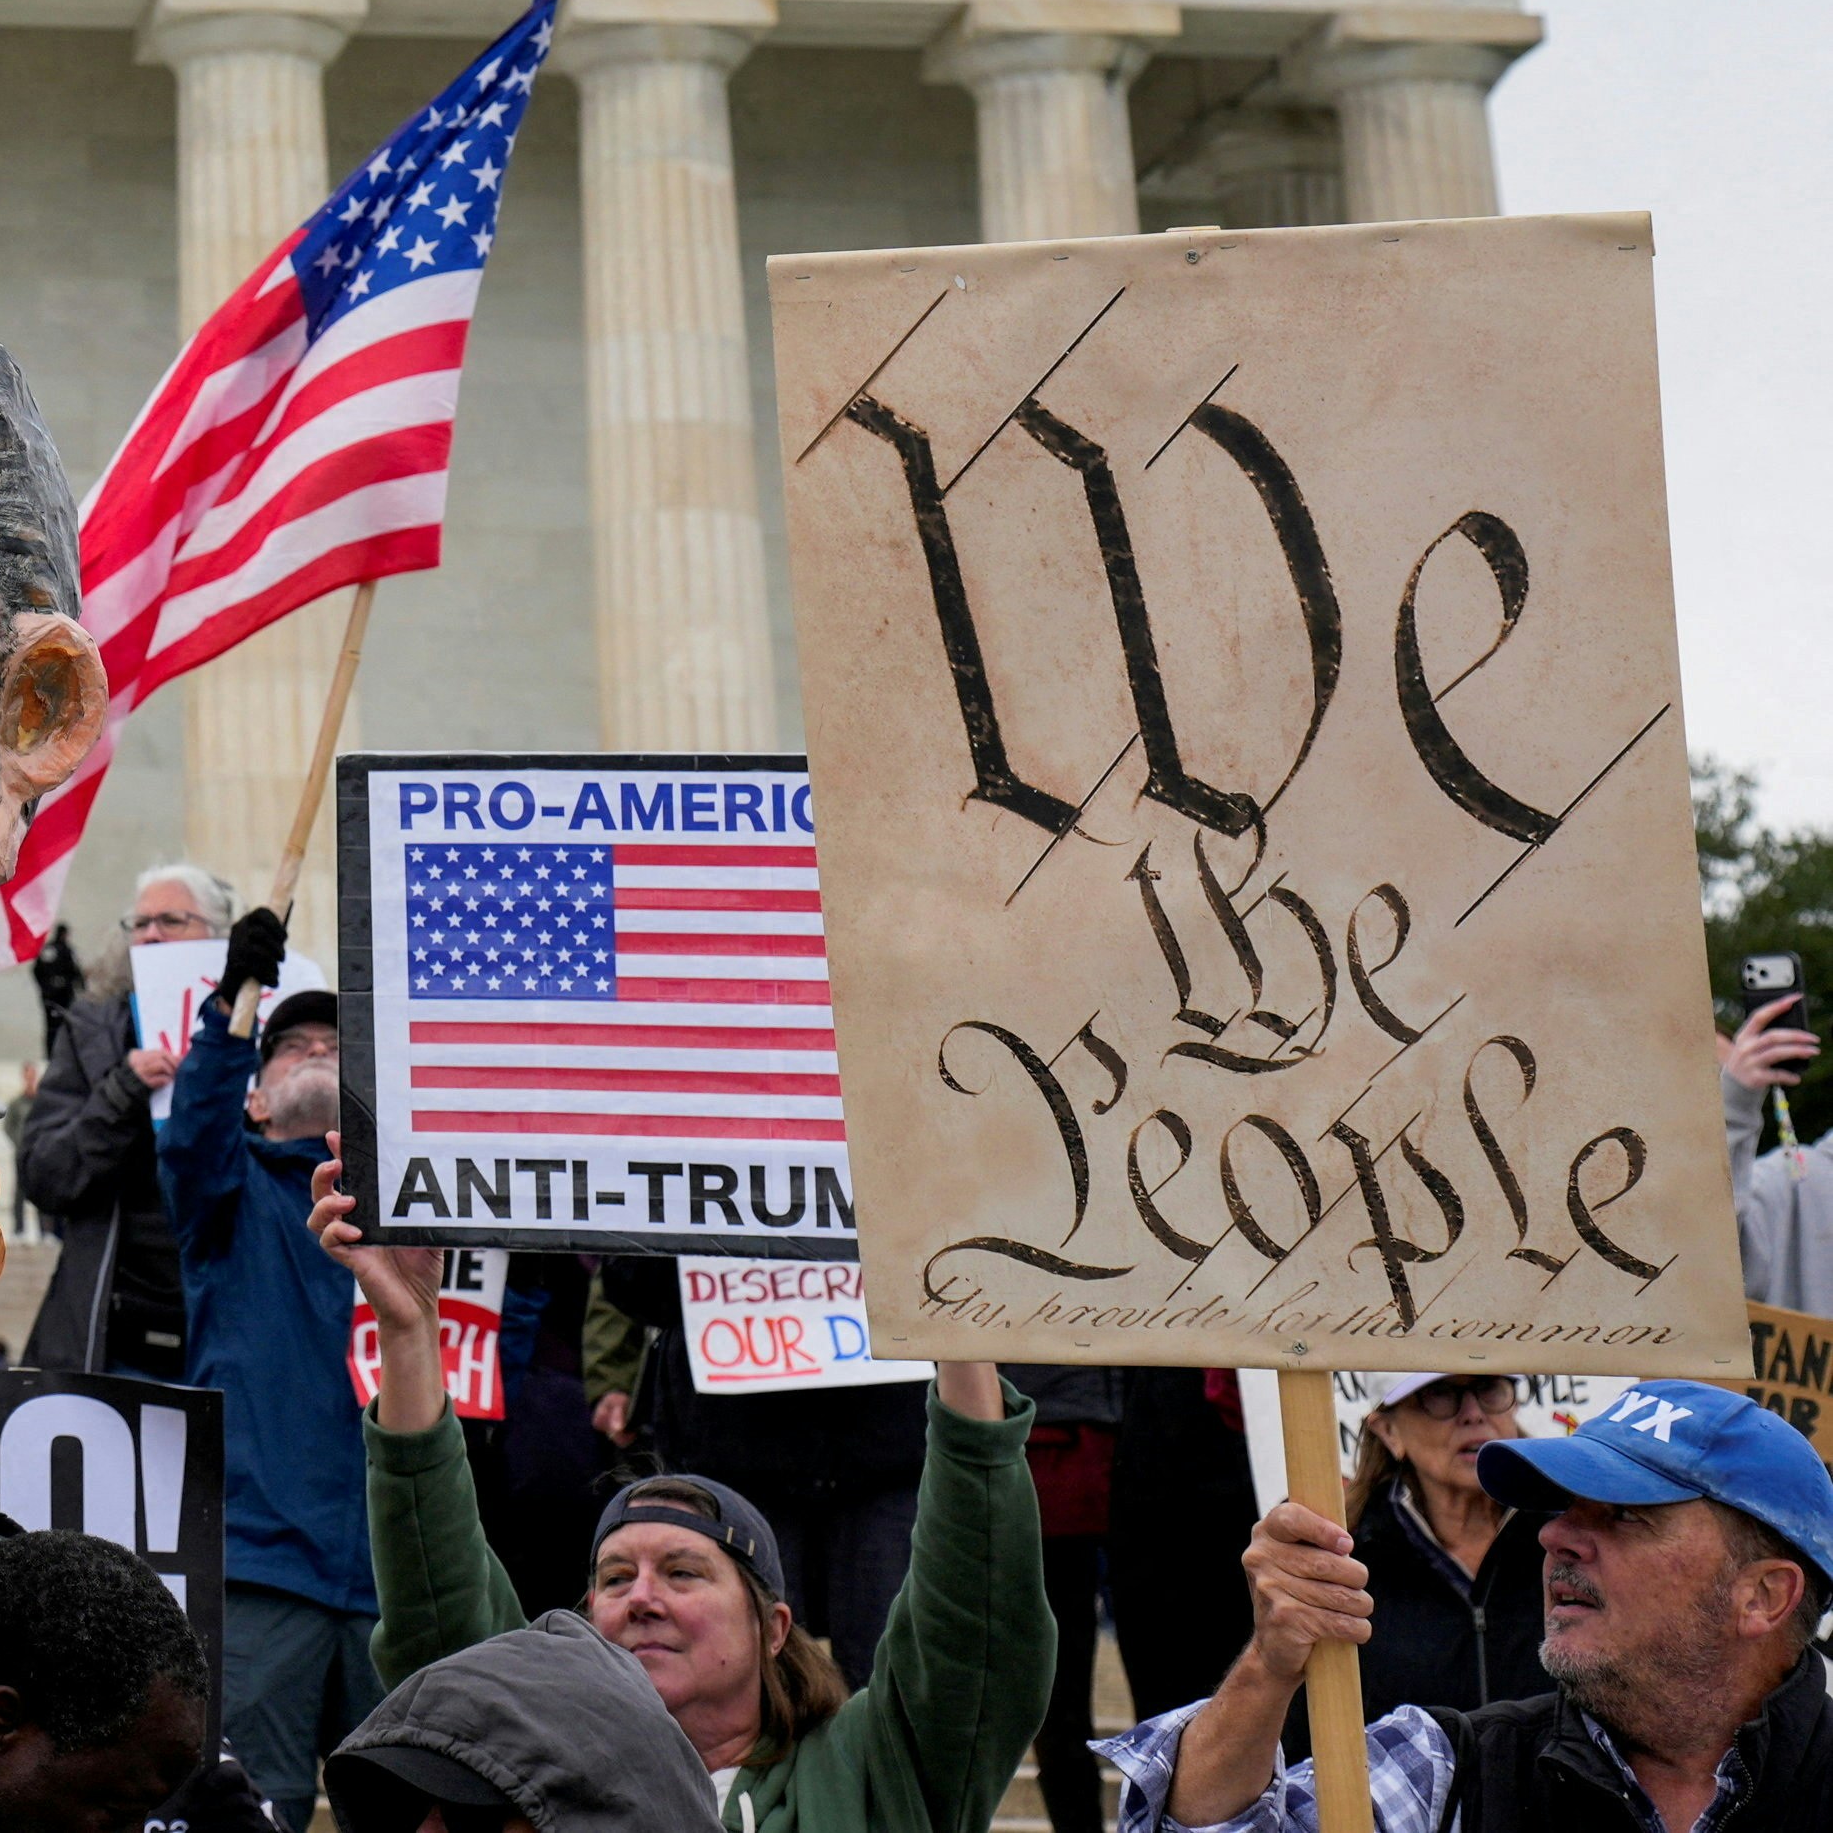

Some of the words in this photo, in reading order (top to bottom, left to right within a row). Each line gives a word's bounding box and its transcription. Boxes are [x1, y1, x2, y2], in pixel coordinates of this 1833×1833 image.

[797, 285, 1670, 926] We
[1125, 814, 1465, 1075] the
[922, 1010, 1679, 1331] People
[701, 1315, 816, 1372] OUR
[1429, 1316, 1687, 1346] common
[1608, 1390, 1695, 1444] YX
